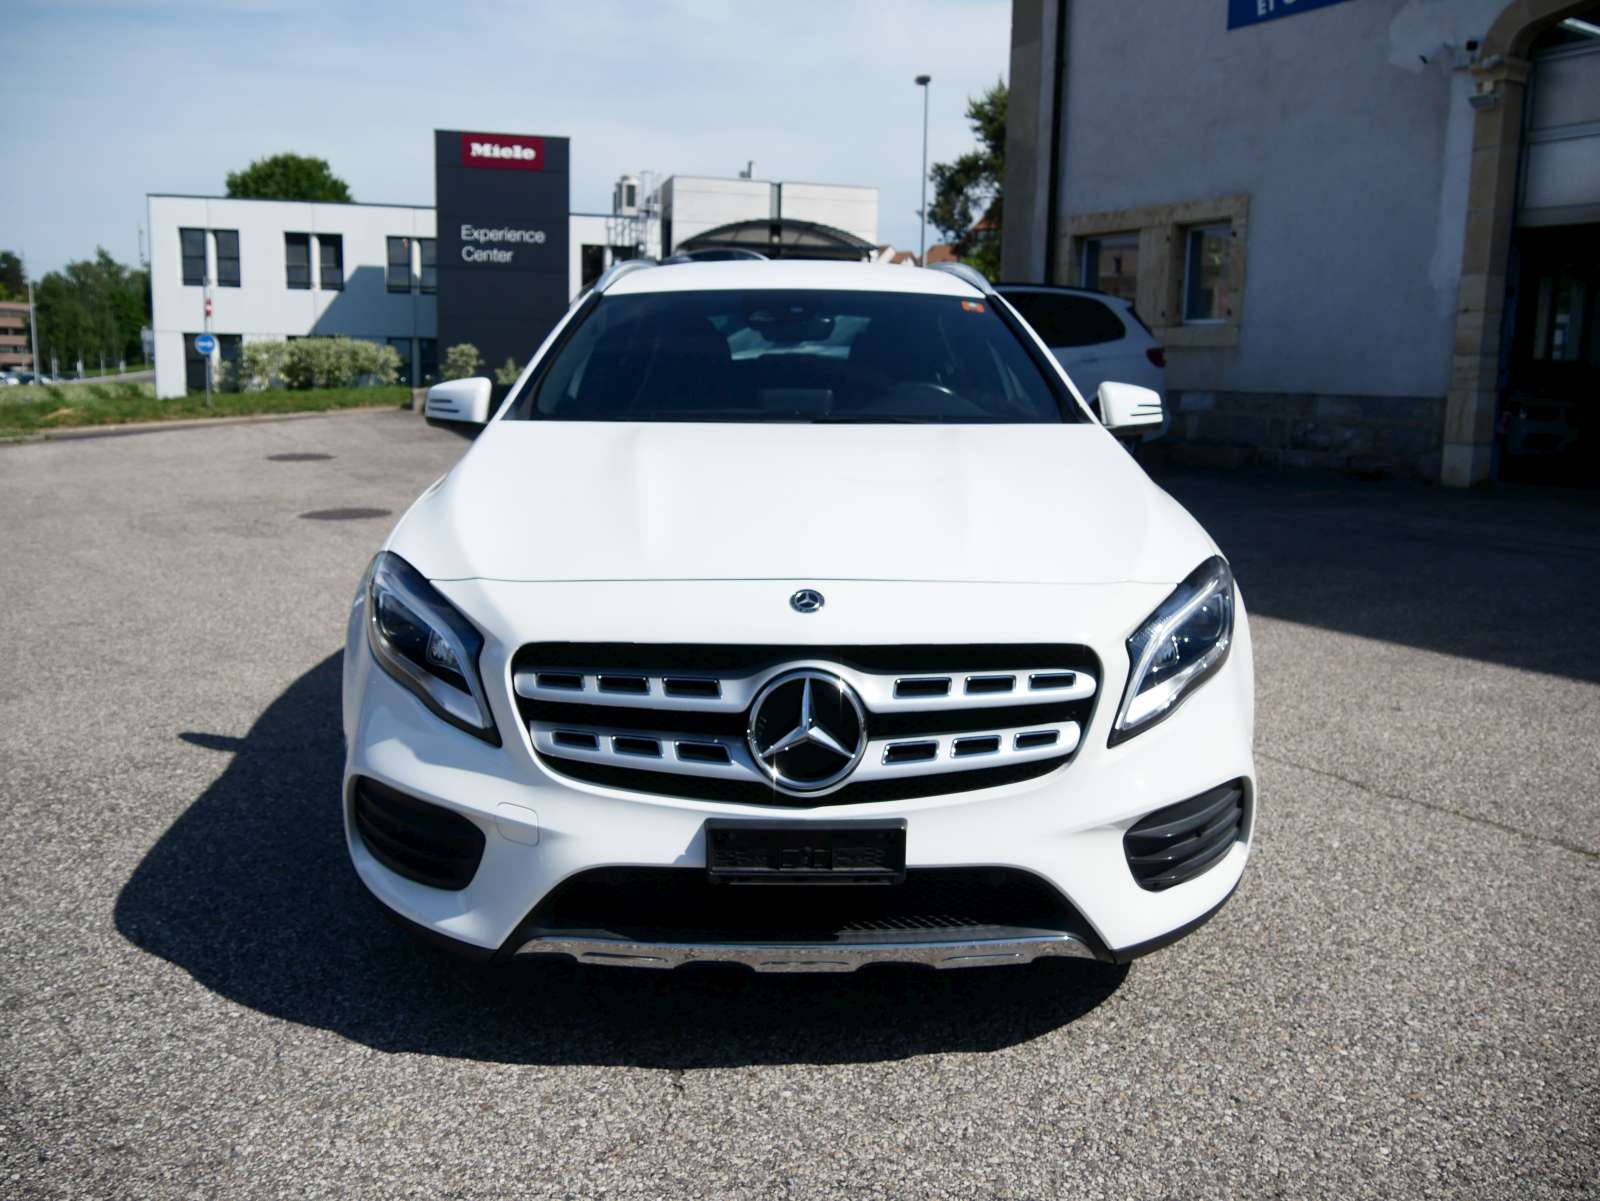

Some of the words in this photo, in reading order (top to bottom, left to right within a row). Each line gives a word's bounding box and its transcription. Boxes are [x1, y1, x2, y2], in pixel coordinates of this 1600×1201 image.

[470, 142, 536, 160] Miele
[460, 224, 546, 243] Experience
[461, 245, 514, 262] Center
